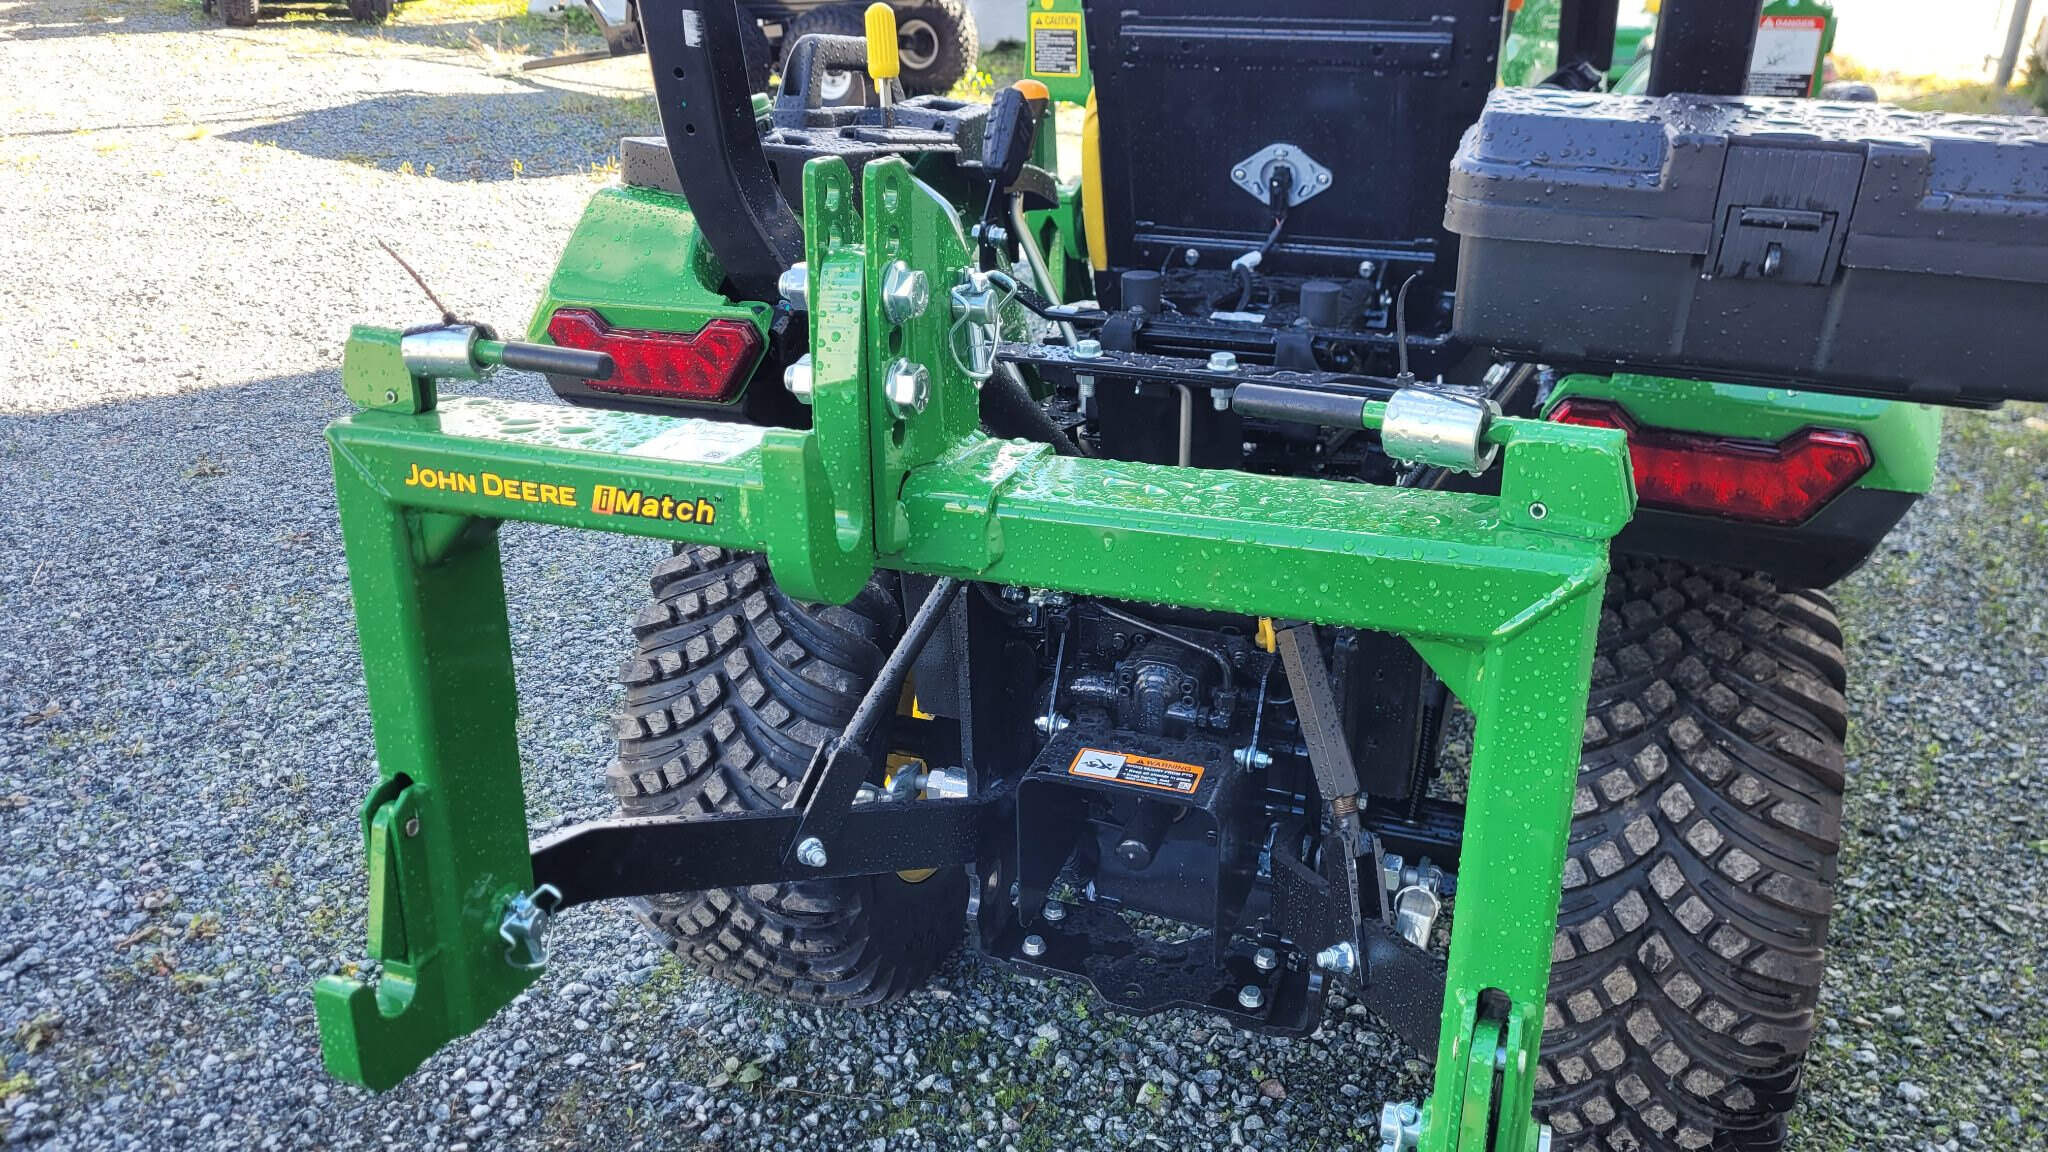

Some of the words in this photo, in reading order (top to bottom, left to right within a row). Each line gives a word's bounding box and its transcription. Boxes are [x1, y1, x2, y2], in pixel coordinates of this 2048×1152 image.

[1044, 16, 1077, 25] CAUTION
[1775, 18, 1815, 28] DANGER
[405, 463, 476, 494] JOHN
[481, 471, 577, 507] DEERE
[1146, 760, 1192, 772] WARNING
